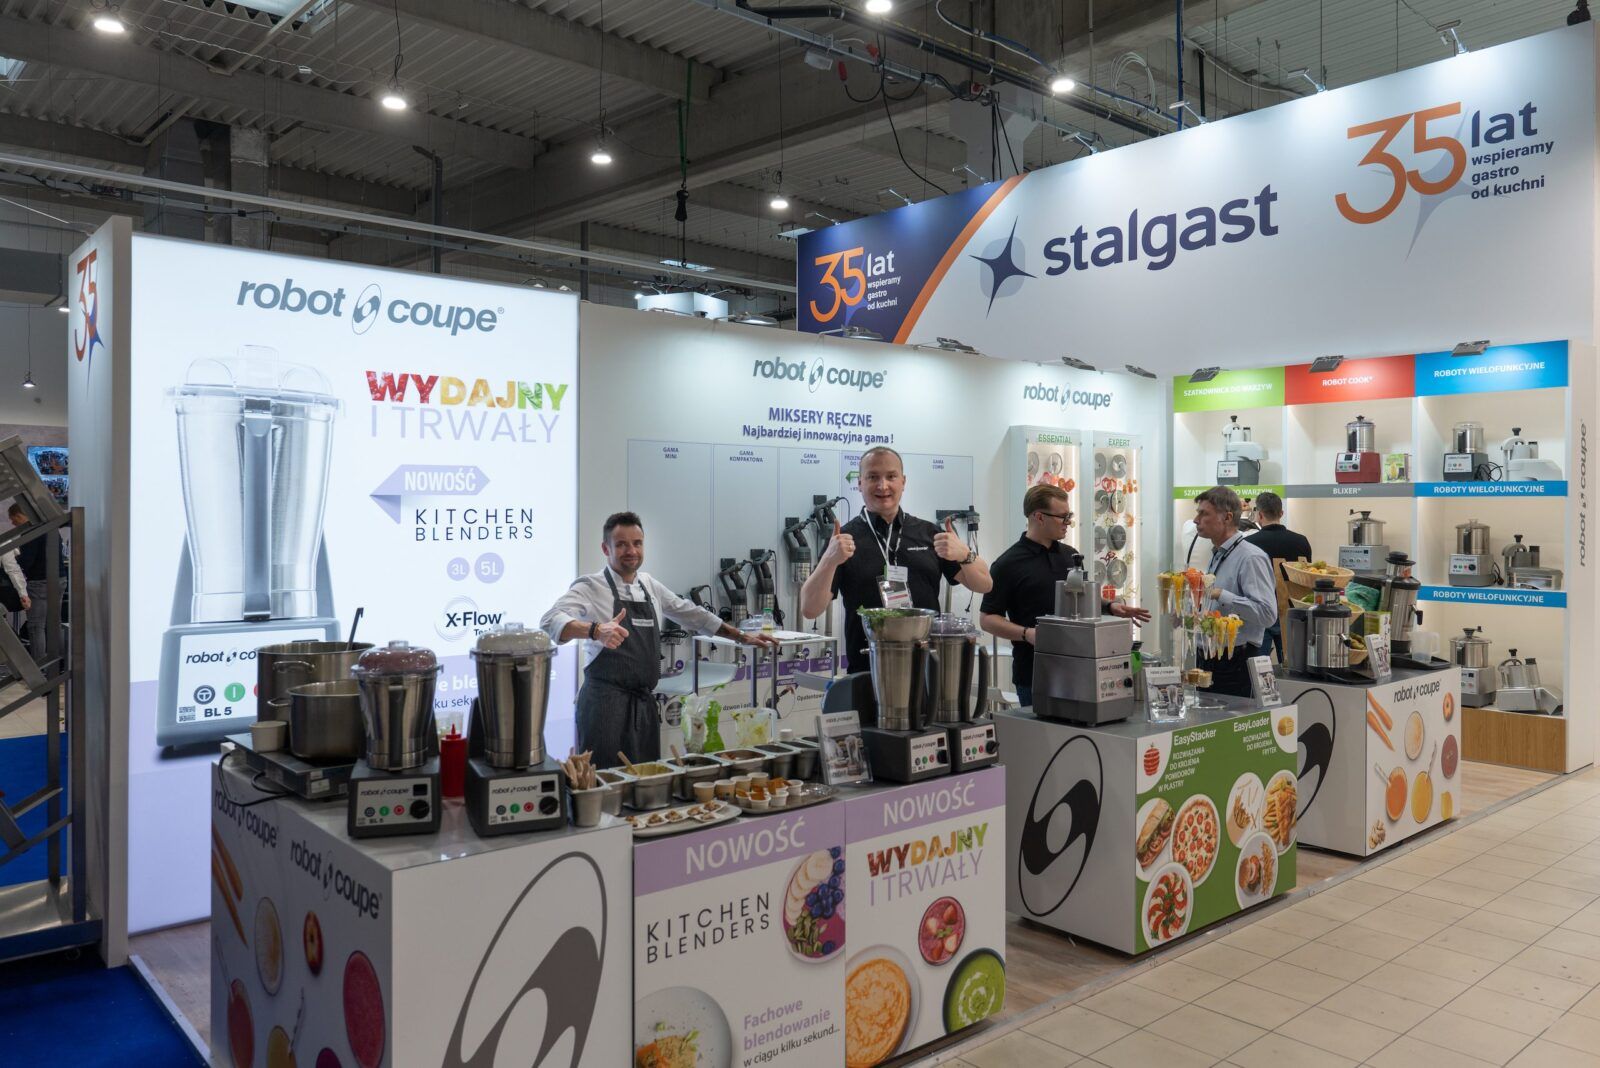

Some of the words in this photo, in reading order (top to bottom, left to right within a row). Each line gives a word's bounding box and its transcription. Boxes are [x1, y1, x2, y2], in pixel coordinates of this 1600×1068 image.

[1335, 102, 1467, 224] 35
[1471, 101, 1538, 148] lat
[1471, 140, 1555, 166] wspieramy
[1471, 164, 1520, 186] gastro
[1471, 182, 1490, 200] od
[1493, 175, 1545, 197] kuchni
[1043, 184, 1279, 277] stalgast
[810, 247, 867, 323] 35
[867, 250, 895, 278] lat
[867, 276, 901, 289] wspieramy
[236, 278, 346, 318] robot
[867, 290, 888, 301] gastro
[867, 301, 876, 311] od
[876, 297, 898, 309] kuchni
[753, 356, 806, 382] robot
[1434, 368, 1467, 378] ROBOTY
[1468, 361, 1546, 376] WIELOFUNKCYJNE
[365, 370, 569, 412] WYDAJNY
[1023, 382, 1059, 403] robot
[1322, 377, 1346, 386] ROBOT
[371, 404, 378, 438] I
[392, 406, 560, 443] TRWAŁY
[768, 407, 824, 425] MIKSERY
[826, 411, 873, 429] RĘCZNE
[743, 425, 802, 441] Najbardziej
[803, 428, 863, 444] innowacyjna
[864, 435, 889, 446] gama
[1038, 433, 1073, 444] ESSENTIAL
[1108, 438, 1130, 447] EXPERT
[404, 467, 477, 492] NOWOŚĆ
[1434, 485, 1467, 494] ROBOTY
[1468, 485, 1545, 494] WIELOFUNKCYJNE
[416, 508, 533, 525] KITCHEN
[415, 526, 533, 541] BLENDERS
[452, 563, 466, 575] 3L
[480, 561, 499, 576] 5L
[1433, 590, 1466, 600] ROBOTY
[1467, 591, 1544, 603] WIELOFUNKCYJNE
[446, 611, 502, 628] X-Flow
[186, 651, 225, 665] robot
[1393, 685, 1413, 703] robot
[1419, 680, 1441, 698] coupe
[204, 708, 222, 718] BL
[224, 706, 233, 716] 5
[1233, 716, 1270, 733] EasyLoader
[1174, 729, 1217, 746] EasyStacker
[883, 778, 976, 828] NOWOŚĆ
[246, 807, 278, 849] coupe
[686, 815, 806, 875] NOWOŚĆ
[867, 822, 989, 878] WYDAJNY
[290, 839, 322, 880] robot
[334, 868, 380, 920] coupe
[870, 879, 875, 907] I
[882, 849, 984, 902] TRWAŁY
[647, 892, 770, 944] KITCHEN
[647, 913, 770, 964] BLENDERS
[744, 999, 804, 1030] Fachowe
[744, 1009, 831, 1051] blendowanie
[743, 1058, 752, 1067] w
[754, 1048, 779, 1065] ciągu
[780, 1039, 802, 1054] kilku
